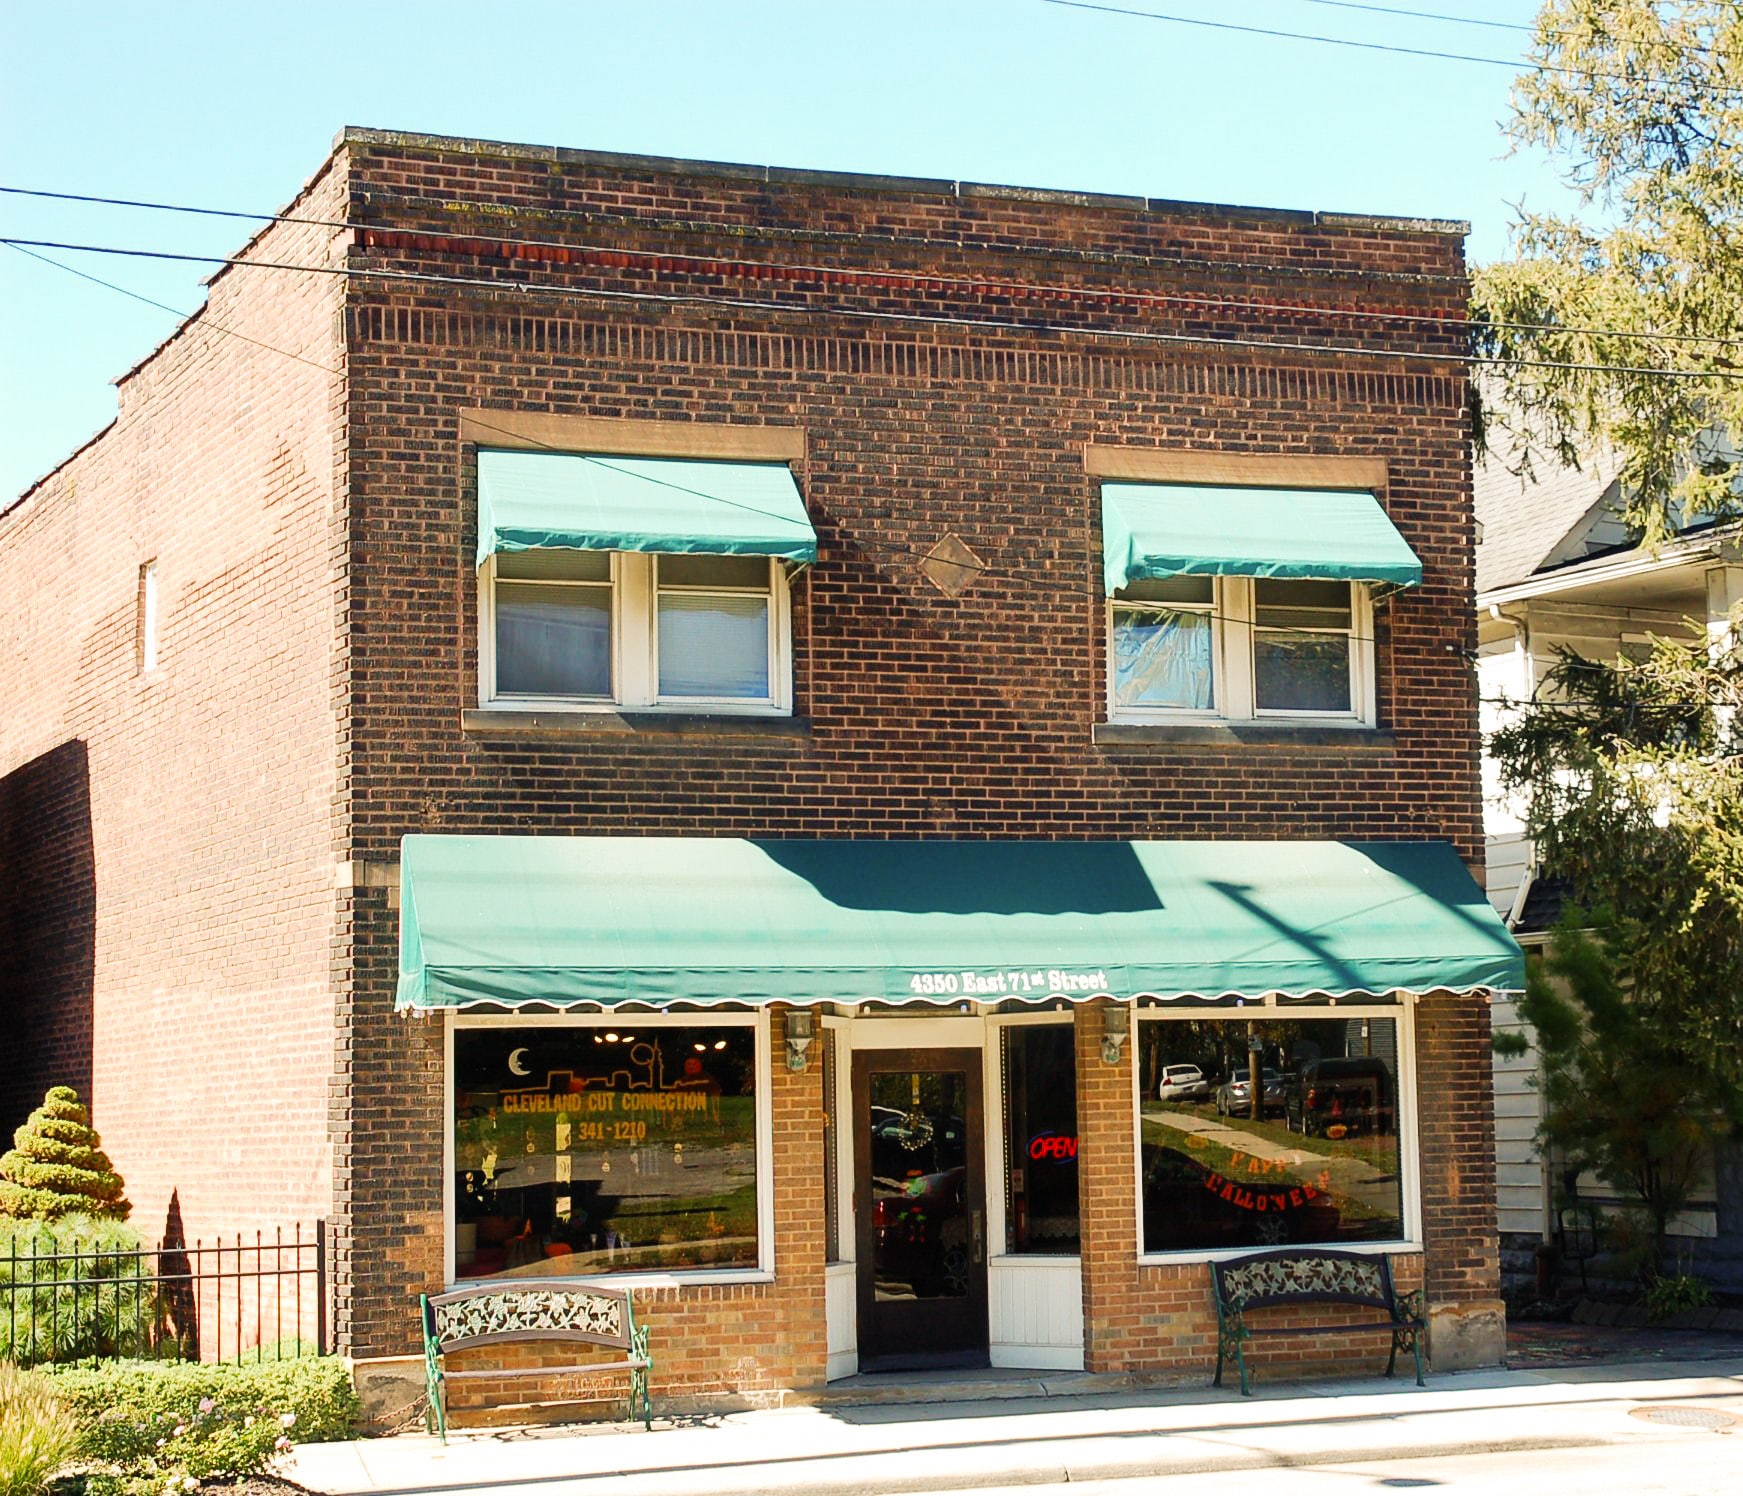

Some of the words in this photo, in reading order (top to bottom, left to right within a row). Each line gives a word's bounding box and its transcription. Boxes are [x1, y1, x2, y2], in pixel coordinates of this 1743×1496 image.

[910, 974, 958, 993] 4350
[961, 972, 1006, 992] East
[1008, 971, 1045, 992] 71st
[1047, 970, 1107, 991] Street
[503, 1094, 581, 1113] CLEVELAND
[588, 1093, 616, 1112] CUT
[621, 1092, 706, 1111] CONNECTION
[1030, 1136, 1078, 1159] OPEN
